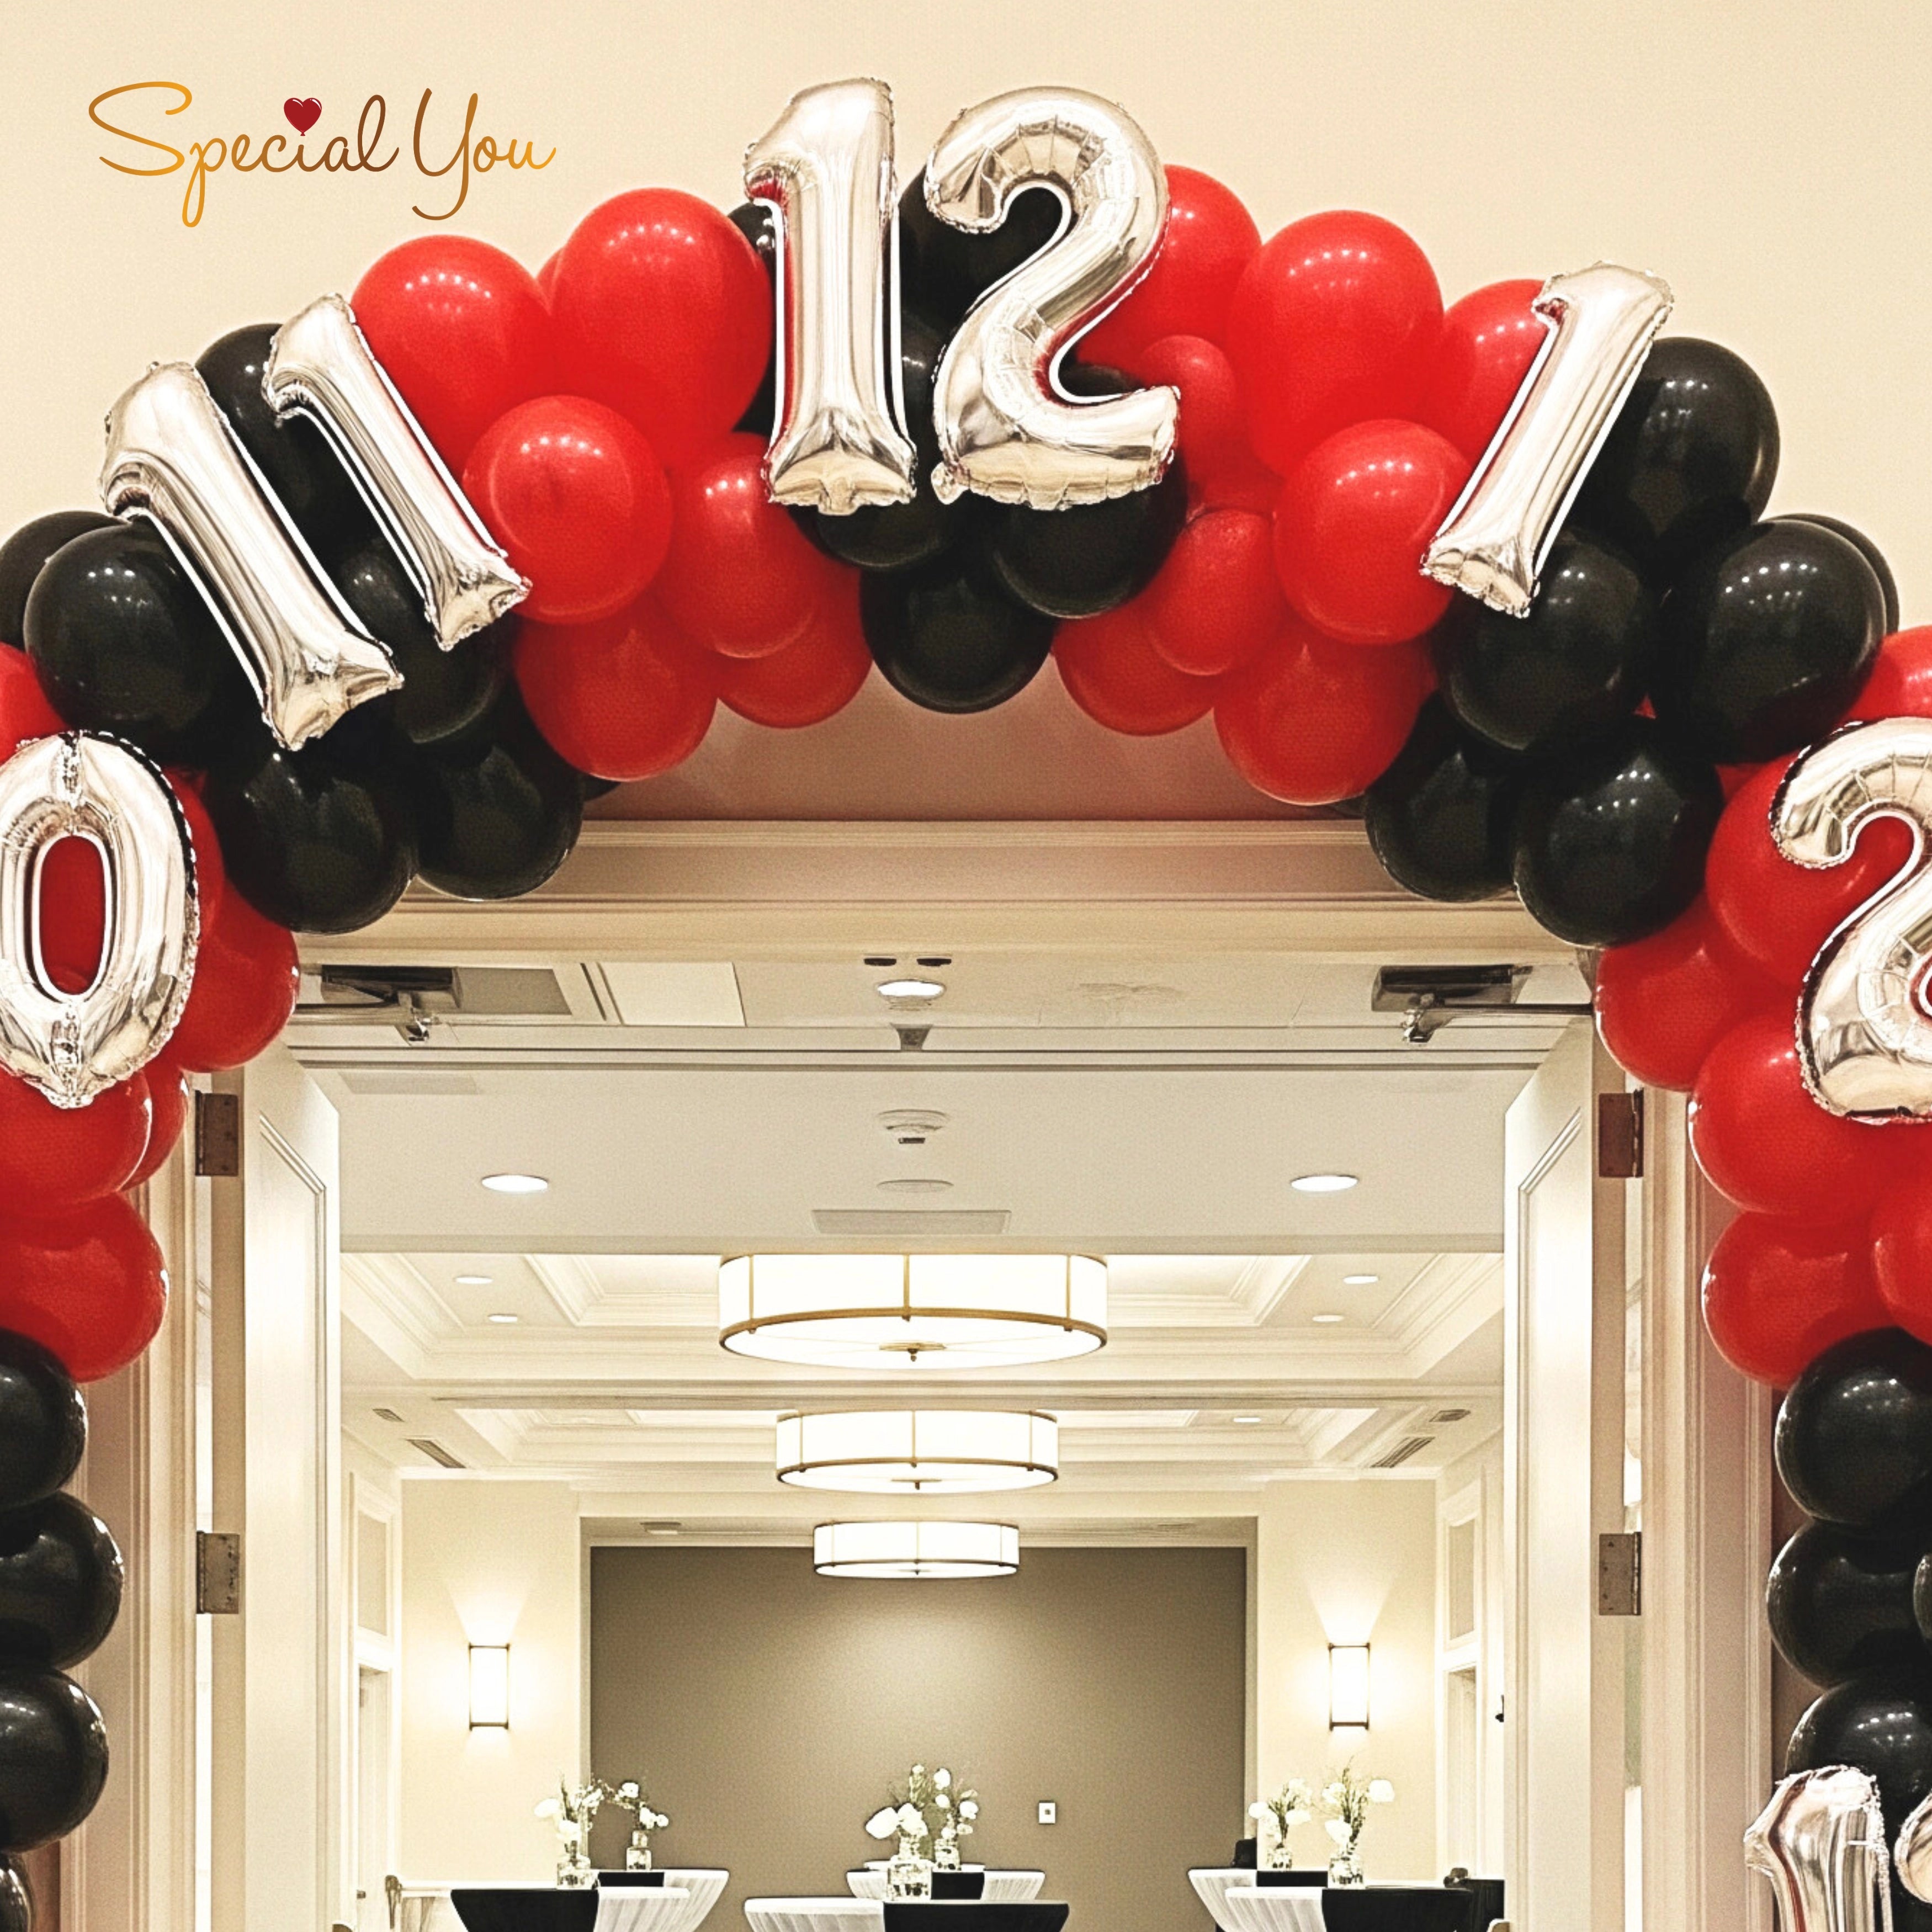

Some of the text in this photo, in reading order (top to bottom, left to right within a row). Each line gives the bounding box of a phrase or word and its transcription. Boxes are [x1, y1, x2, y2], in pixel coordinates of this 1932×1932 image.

[743, 77, 1181, 516] 12
[1419, 260, 1674, 618] 1
[100, 292, 533, 751] 11
